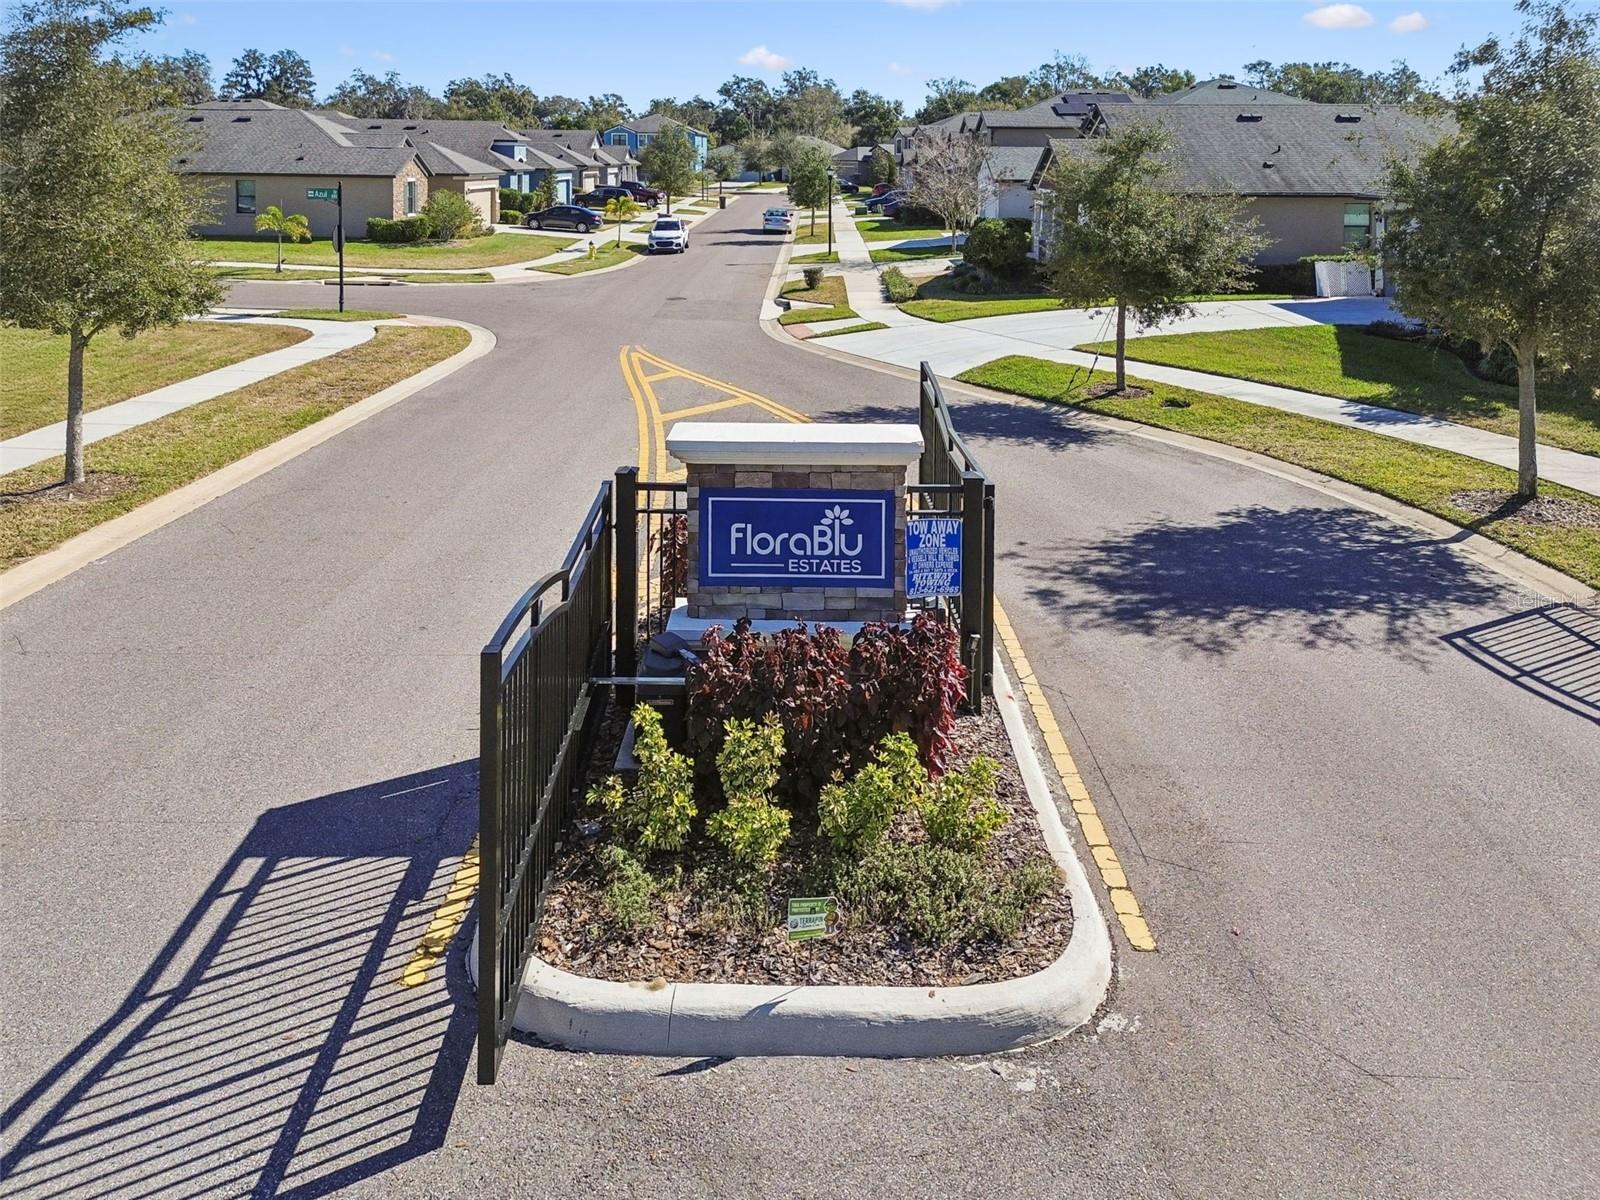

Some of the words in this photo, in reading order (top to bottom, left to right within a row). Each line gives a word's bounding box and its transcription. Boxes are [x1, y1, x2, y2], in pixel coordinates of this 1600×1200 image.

[908, 521, 928, 536] TOW
[930, 520, 959, 535] AWAY
[730, 518, 863, 557] FloraBlu
[919, 534, 946, 548] ZONE
[788, 559, 862, 573] ESTATES
[912, 572, 954, 582] RITEWAY
[914, 578, 951, 588] TOWING
